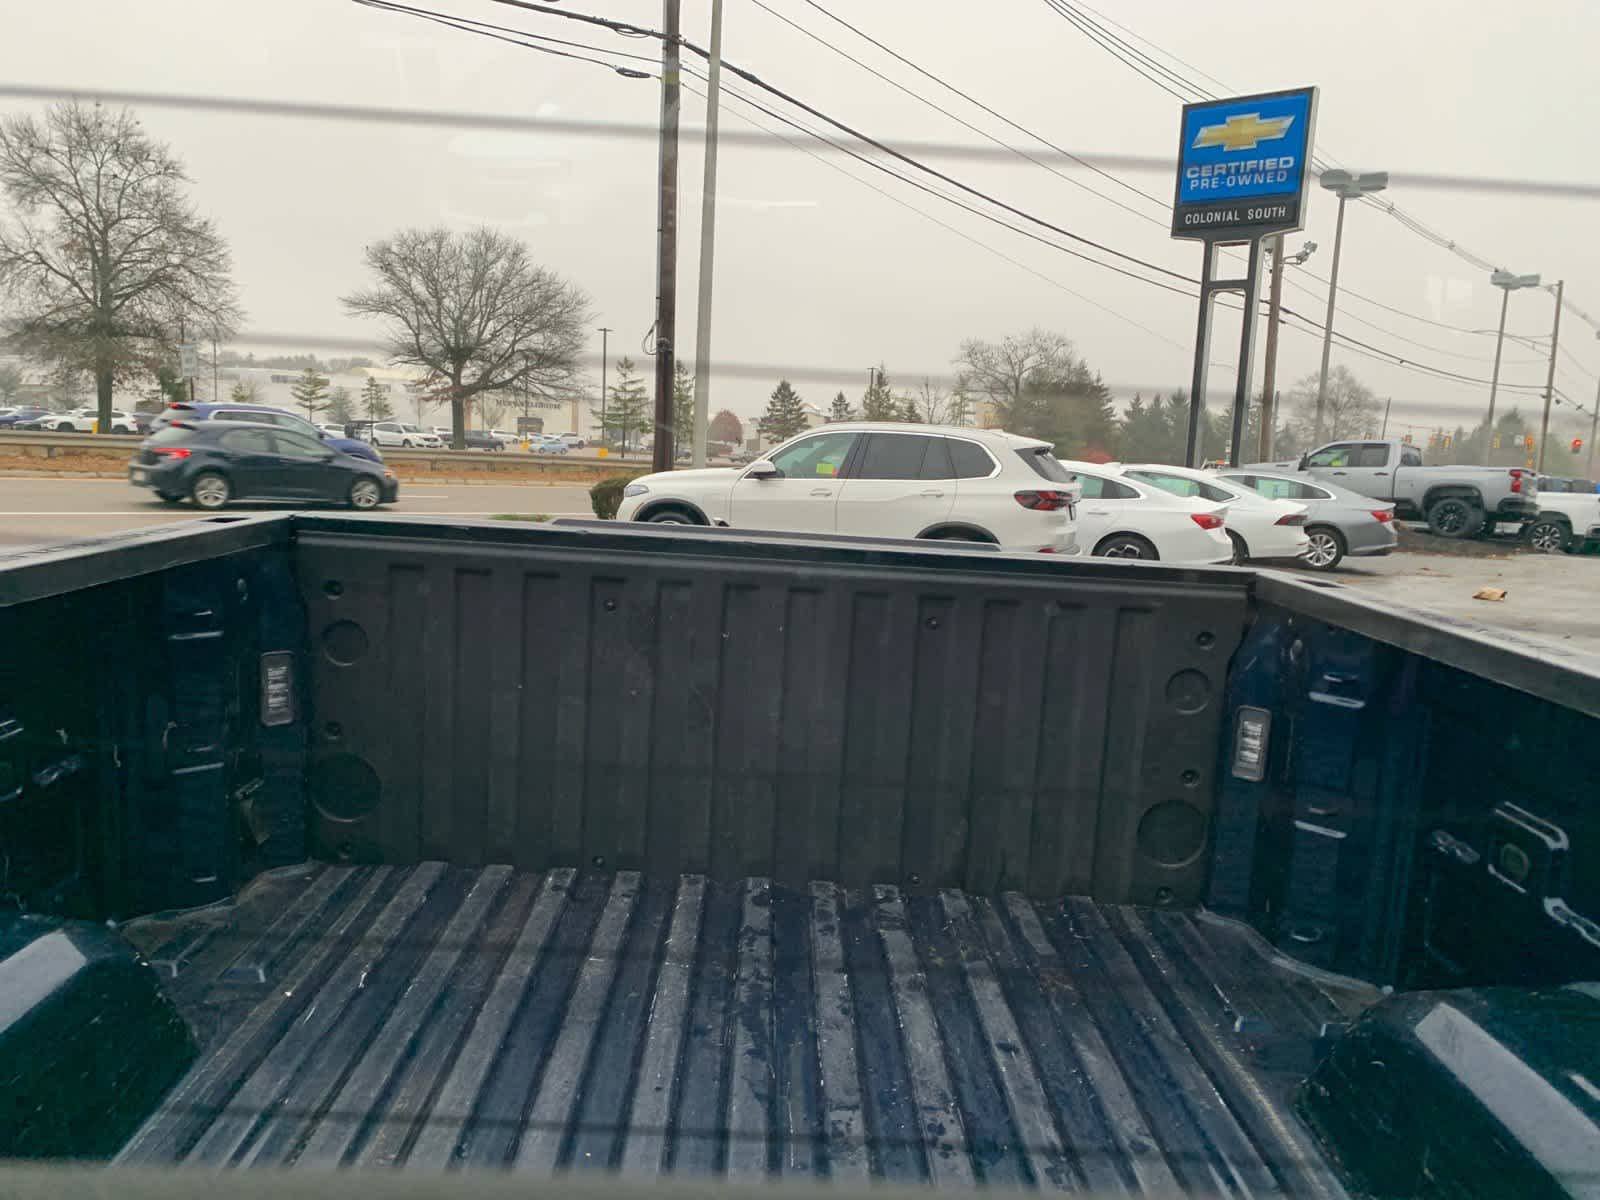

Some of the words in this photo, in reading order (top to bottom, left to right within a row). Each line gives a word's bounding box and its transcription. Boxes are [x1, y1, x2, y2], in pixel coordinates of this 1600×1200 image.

[1186, 157, 1294, 178] CERTIFIED
[1190, 171, 1288, 190] PRE-OWNED
[1185, 208, 1240, 224] COLONIAL
[1247, 206, 1286, 220] SOUTH
